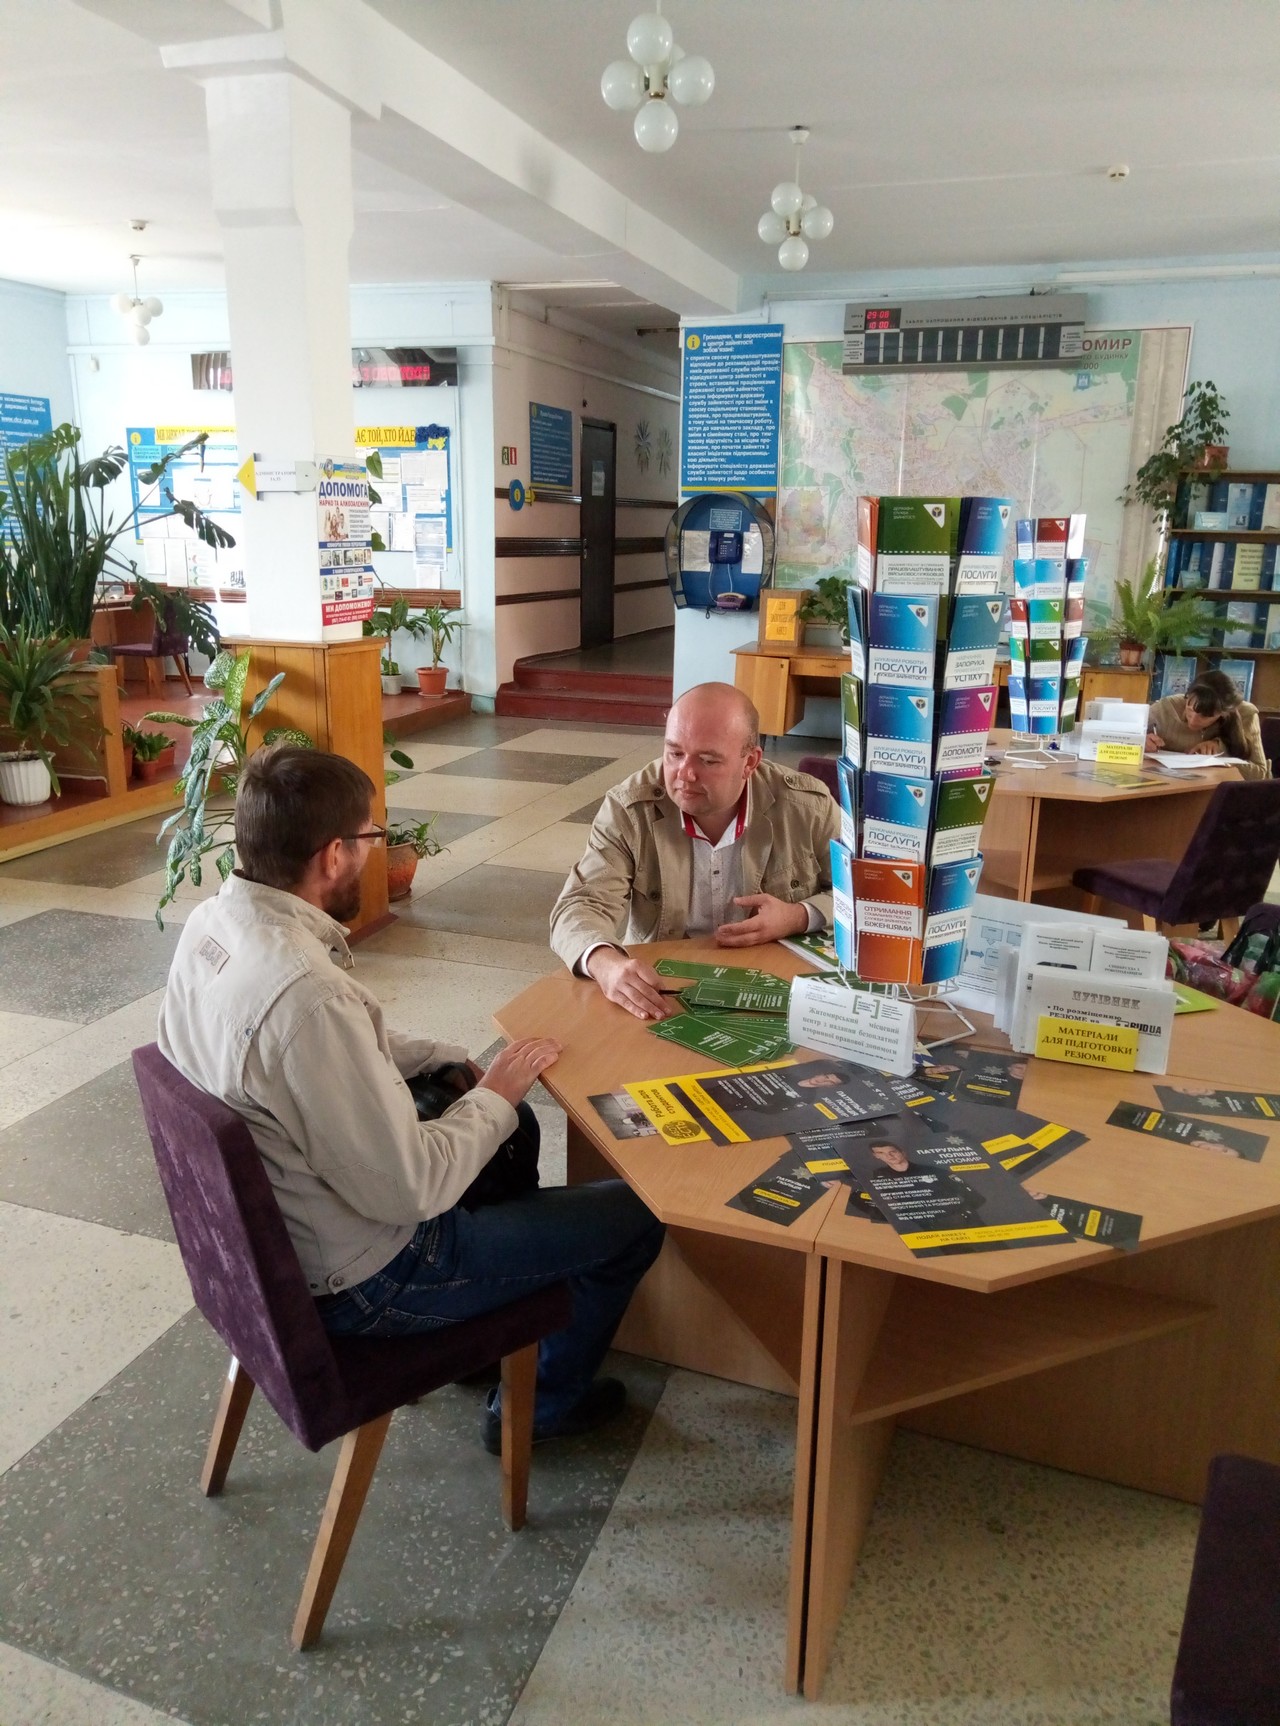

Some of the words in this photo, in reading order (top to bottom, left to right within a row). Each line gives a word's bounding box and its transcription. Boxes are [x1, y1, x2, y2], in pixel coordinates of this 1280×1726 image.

[319, 481, 368, 498] ДОПОМОГА
[961, 570, 997, 579] ПОСЛУГИ
[874, 662, 927, 675] ПОСЛУГИ
[874, 751, 926, 764] ПОСЛУГИ
[942, 747, 982, 757] ДОПОМОГИ
[869, 831, 920, 848] ПОСЛУГИ
[864, 906, 912, 916] ОТРИМАННЯ
[864, 921, 912, 932] БІЖЕНЦЯМИ
[928, 920, 966, 935] ПОСЛУГИ
[809, 1006, 858, 1024] Житомирський
[869, 1022, 899, 1033] місцевий
[1050, 1011, 1087, 1022] РЕЗЮМЕ
[803, 1017, 821, 1028] центр
[859, 1030, 898, 1044] безоплатної
[1058, 1026, 1118, 1041] МАТЕРІАЛИ
[802, 1026, 834, 1039] вторинної
[836, 1034, 863, 1046] правової
[865, 1043, 897, 1055] допомоги
[1042, 1036, 1063, 1045] ДЛЯ
[1065, 1038, 1133, 1055] ПІДГОТОВКИ
[1064, 1049, 1107, 1062] РЕЗЮМЕ
[916, 1146, 973, 1155] ПАТРУЛЬНА
[938, 1151, 978, 1159] ПОЛІЦІЯ
[934, 1156, 982, 1165] ЖИТОМИР
